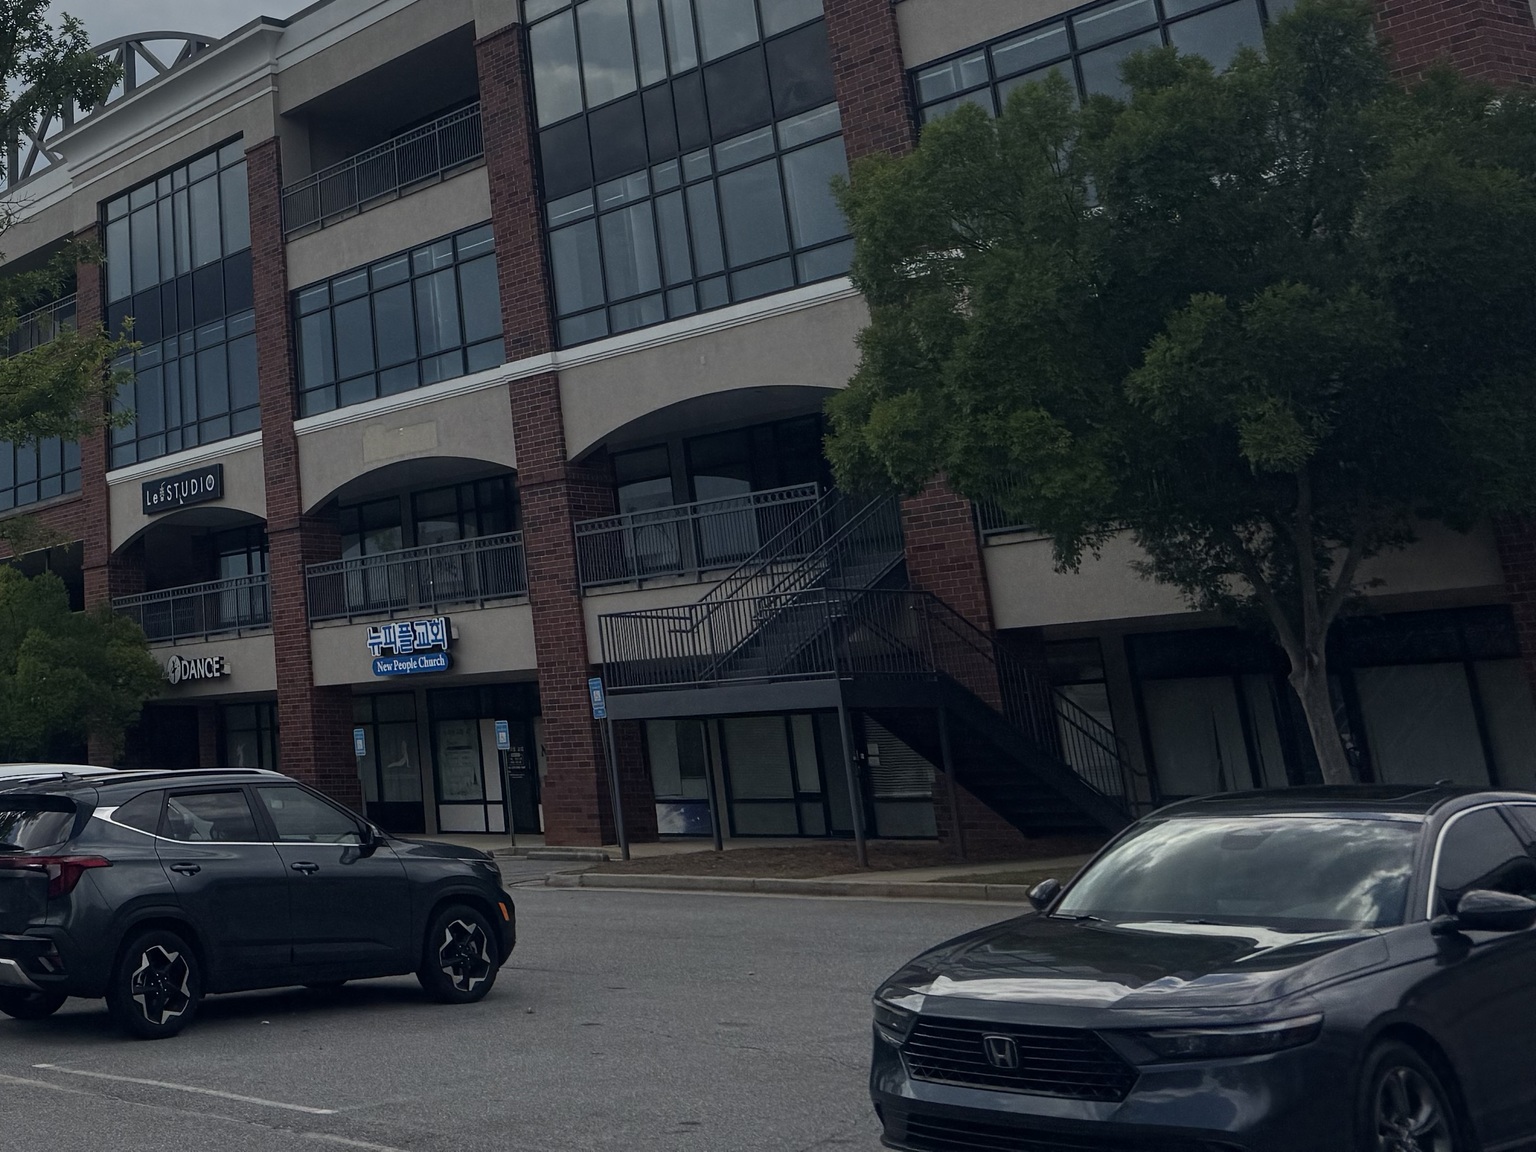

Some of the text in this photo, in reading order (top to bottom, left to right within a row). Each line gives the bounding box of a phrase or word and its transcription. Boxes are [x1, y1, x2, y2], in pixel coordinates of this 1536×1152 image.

[166, 474, 215, 501] STUDIO
[367, 617, 447, 656] 뉴피플 교회
[181, 656, 220, 680] DANCE
[376, 654, 446, 673] New People Church
